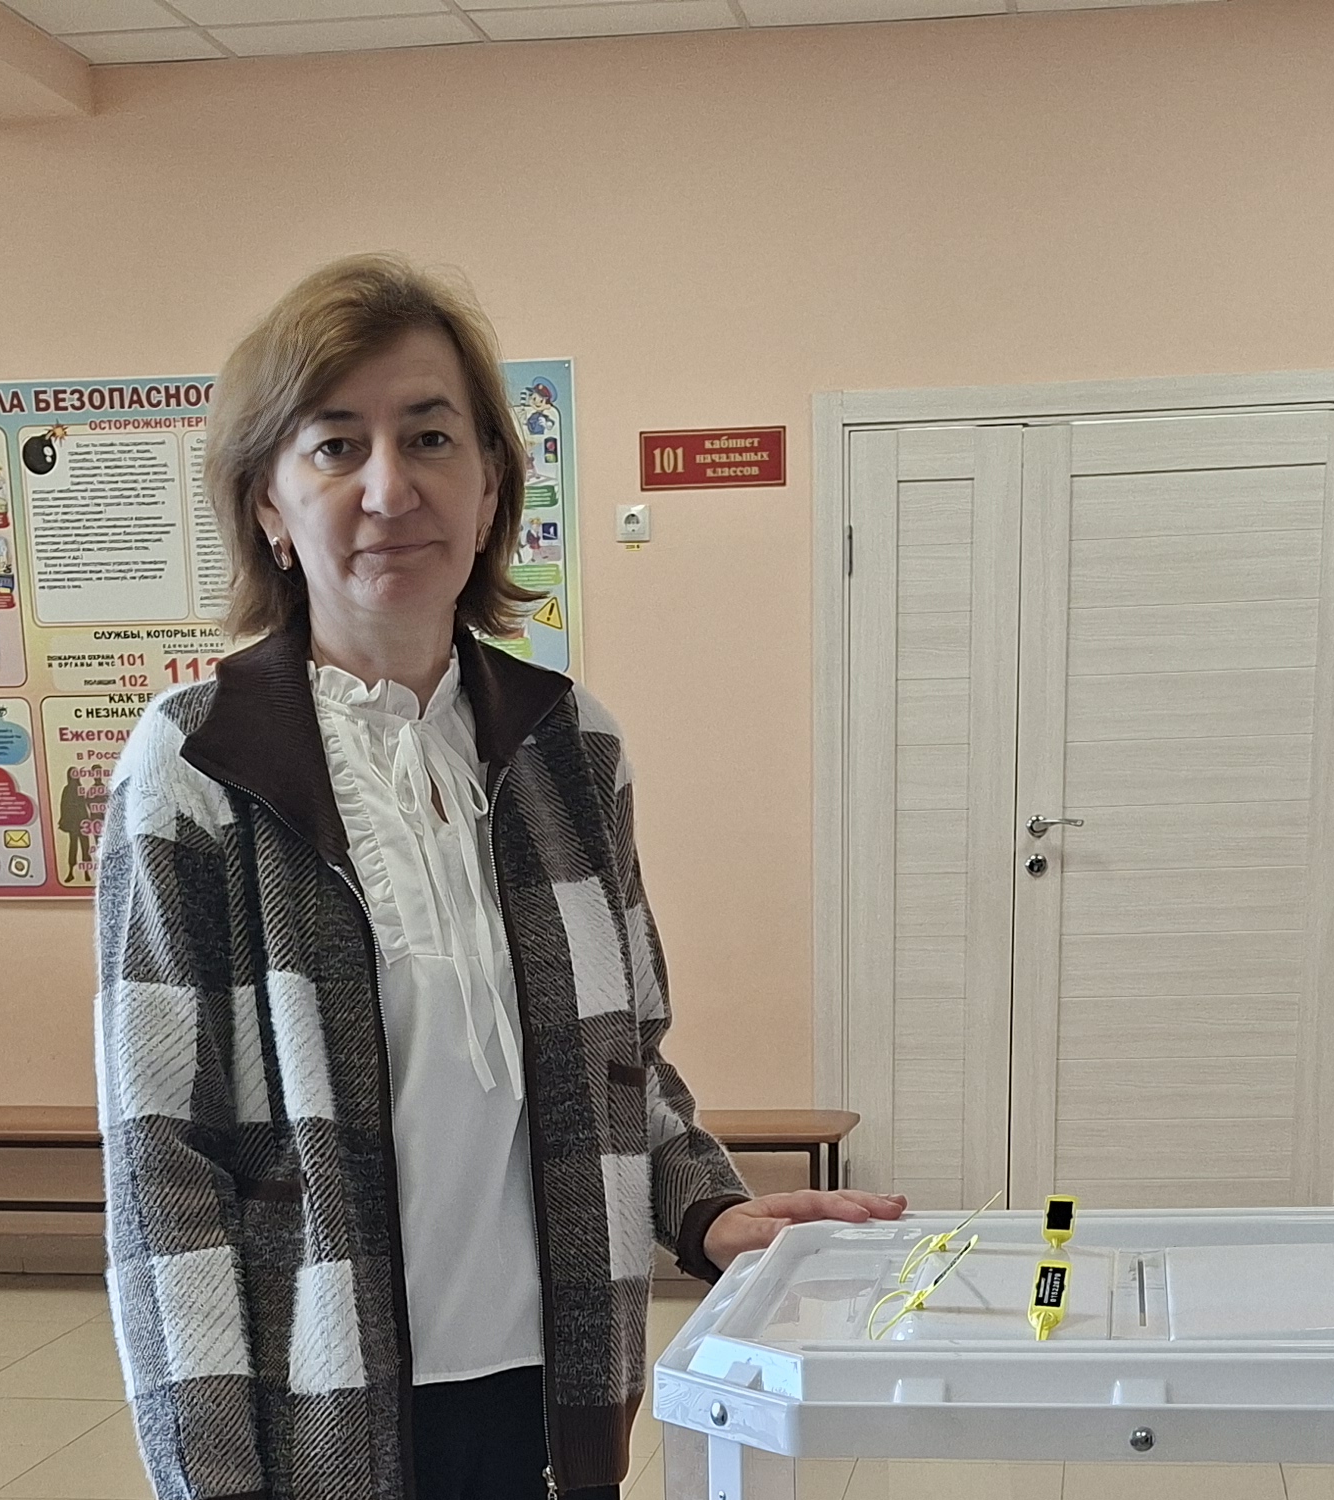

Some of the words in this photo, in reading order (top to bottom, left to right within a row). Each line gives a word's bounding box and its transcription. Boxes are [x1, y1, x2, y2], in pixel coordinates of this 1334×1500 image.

[88, 417, 176, 431] ОСТОРОЖНО!
[704, 435, 761, 449] кабинет
[652, 447, 685, 474] 101
[695, 451, 770, 463] начальных
[706, 466, 760, 477] классов
[93, 630, 144, 640] СЛУЖБЫ,
[146, 629, 197, 639] КОТОРЫЕ
[117, 653, 145, 667] 101
[119, 675, 148, 687] 102
[108, 692, 134, 704] КАК
[138, 692, 156, 703] ВЕ
[74, 708, 82, 718] С
